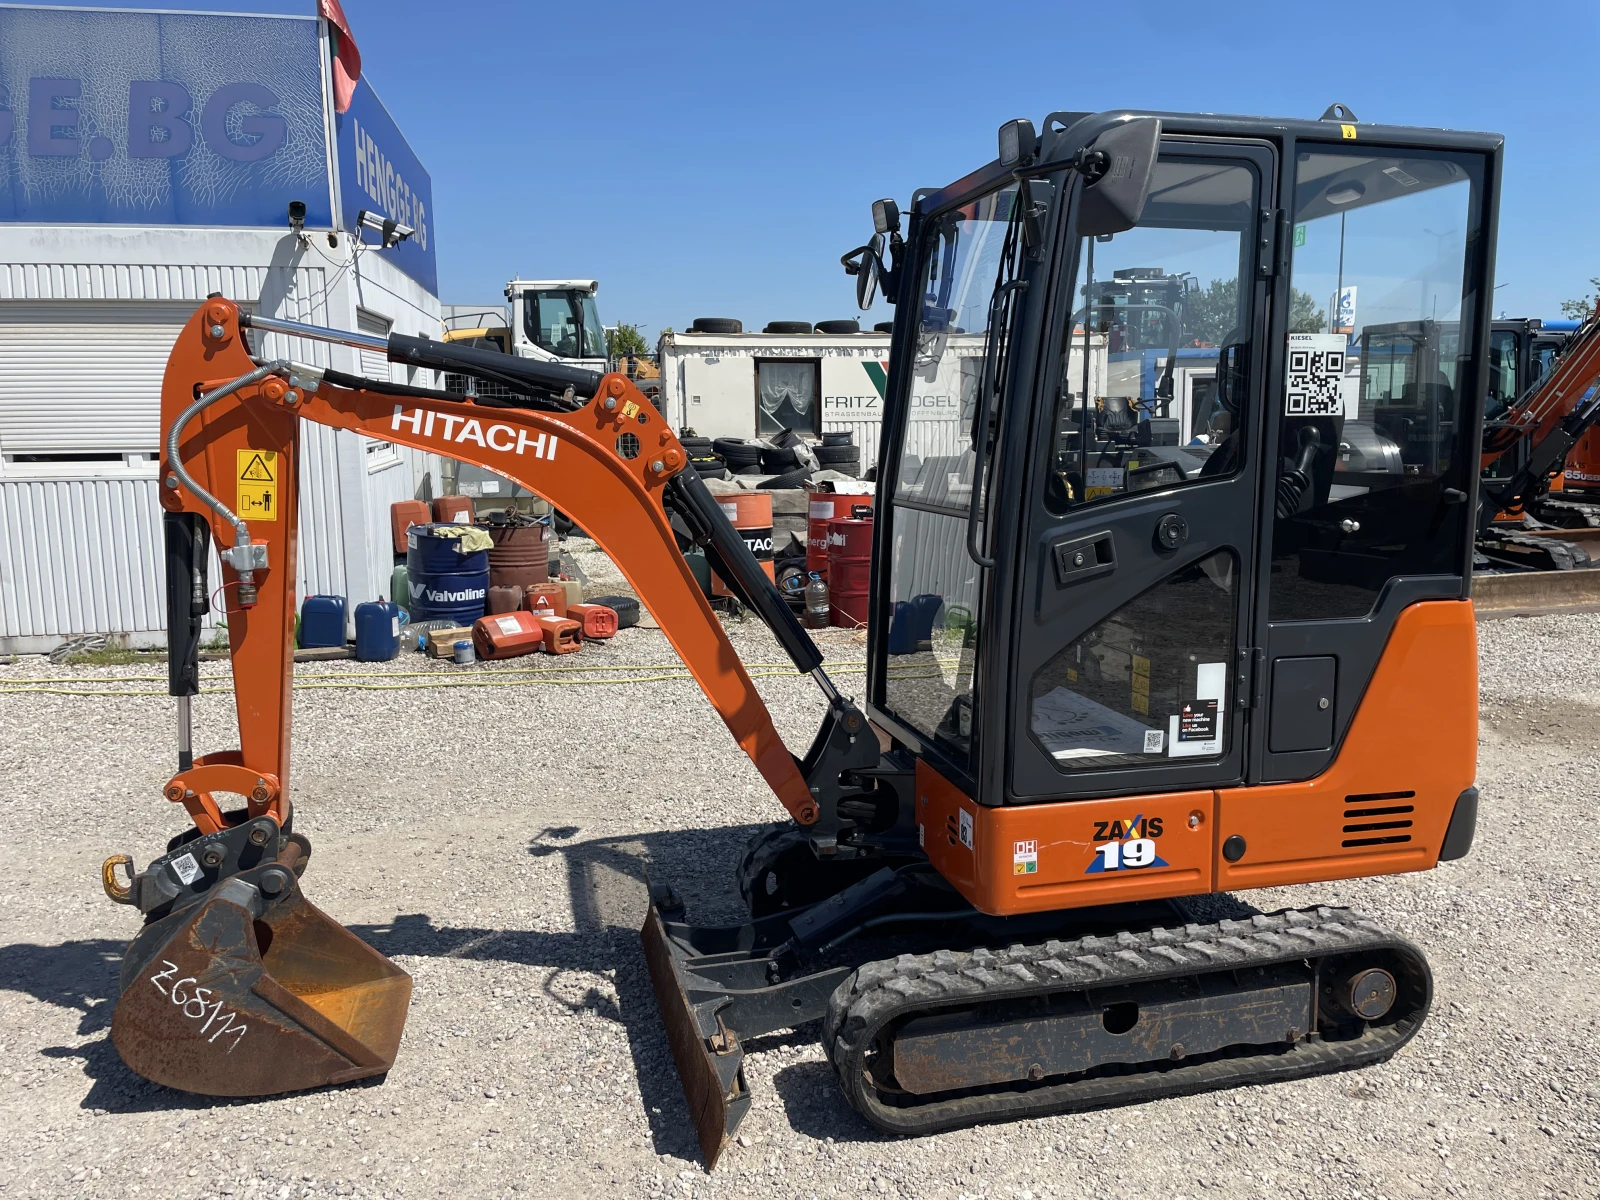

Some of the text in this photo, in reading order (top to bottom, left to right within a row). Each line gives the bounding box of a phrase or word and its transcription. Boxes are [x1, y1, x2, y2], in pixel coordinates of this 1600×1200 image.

[0, 77, 285, 161] E.BG
[824, 396, 877, 408] FRITZ
[391, 404, 558, 461] HITACHI
[426, 588, 485, 602] Valvoline
[1093, 814, 1163, 841] ZAXIS
[1095, 838, 1156, 871] 19
[151, 959, 247, 1054] Z68111
